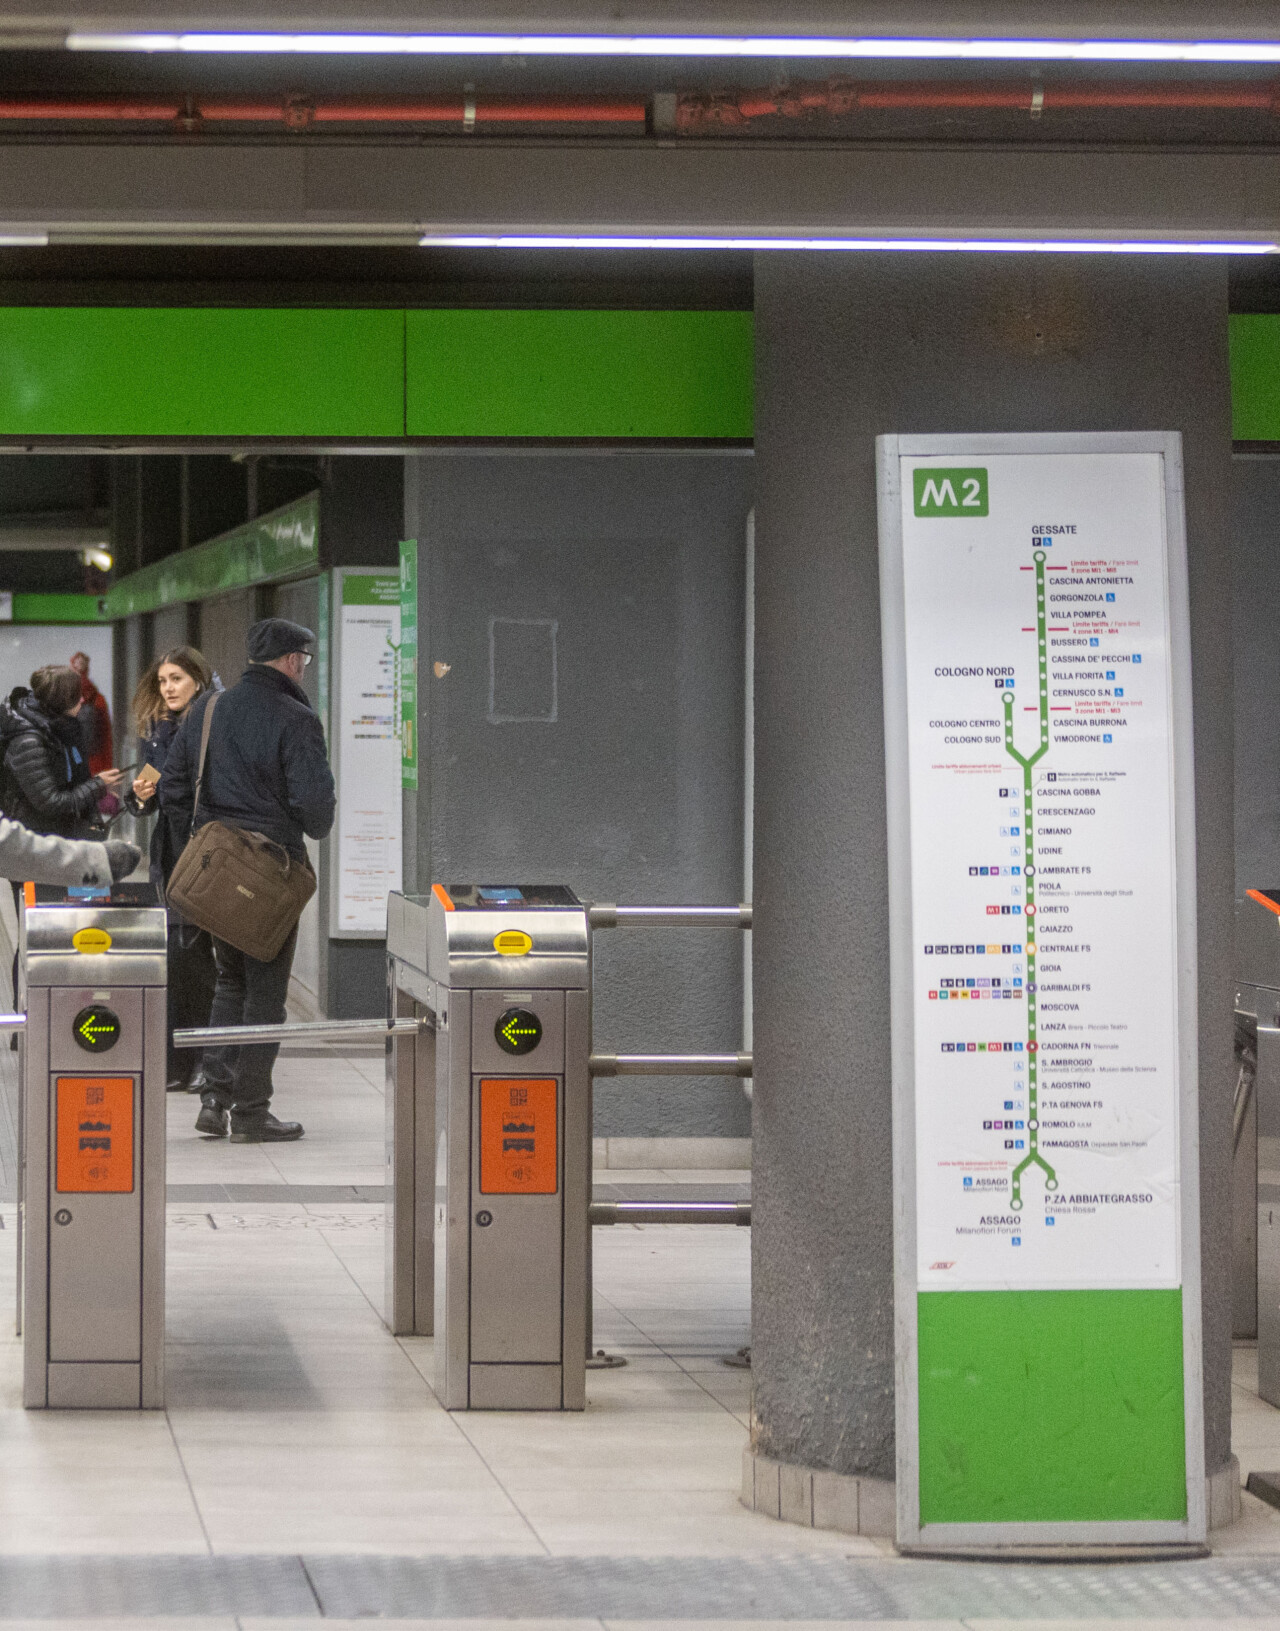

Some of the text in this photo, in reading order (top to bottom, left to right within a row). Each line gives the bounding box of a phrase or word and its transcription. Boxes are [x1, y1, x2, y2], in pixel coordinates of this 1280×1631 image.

[920, 478, 981, 507] M2
[1032, 525, 1077, 535] GESSATE
[1049, 577, 1134, 585] CASCINA ANTONIETTA
[1050, 594, 1104, 602] GORGONZOLA
[1051, 611, 1107, 619] VILLA POMPEA
[934, 667, 1015, 677] COLOGNO NORD
[1052, 672, 1105, 680] VILLA FIORITA
[1052, 689, 1113, 697] CERNUSCO S.N.
[929, 720, 1001, 728] COLOGNO CENTRO
[1053, 719, 1127, 727] CASCINA BURRONA
[944, 736, 1002, 744] COLOGNO SUD
[1054, 735, 1102, 743] VIMODRONE
[1037, 808, 1096, 816] CRESCENZAGO
[1038, 867, 1091, 875] LAMBRATE FS
[1038, 882, 1061, 890] PIOLA
[1039, 925, 1073, 933] CAIAZZO
[1040, 945, 1091, 953] CENTRALE FS
[1040, 984, 1091, 992] GARIBALDI FS
[1050, 1059, 1093, 1067] AMBROGIO
[1041, 1101, 1103, 1109] P.TA GENOVA FS
[976, 1178, 1008, 1186] ASSAGO
[1044, 1194, 1153, 1204] P.ZA ABBIATEGRASSO
[1045, 1206, 1096, 1214] Chiesa Rossa
[980, 1216, 1021, 1225] ASSAGO
[955, 1227, 1022, 1235] Milanofiori Forum
